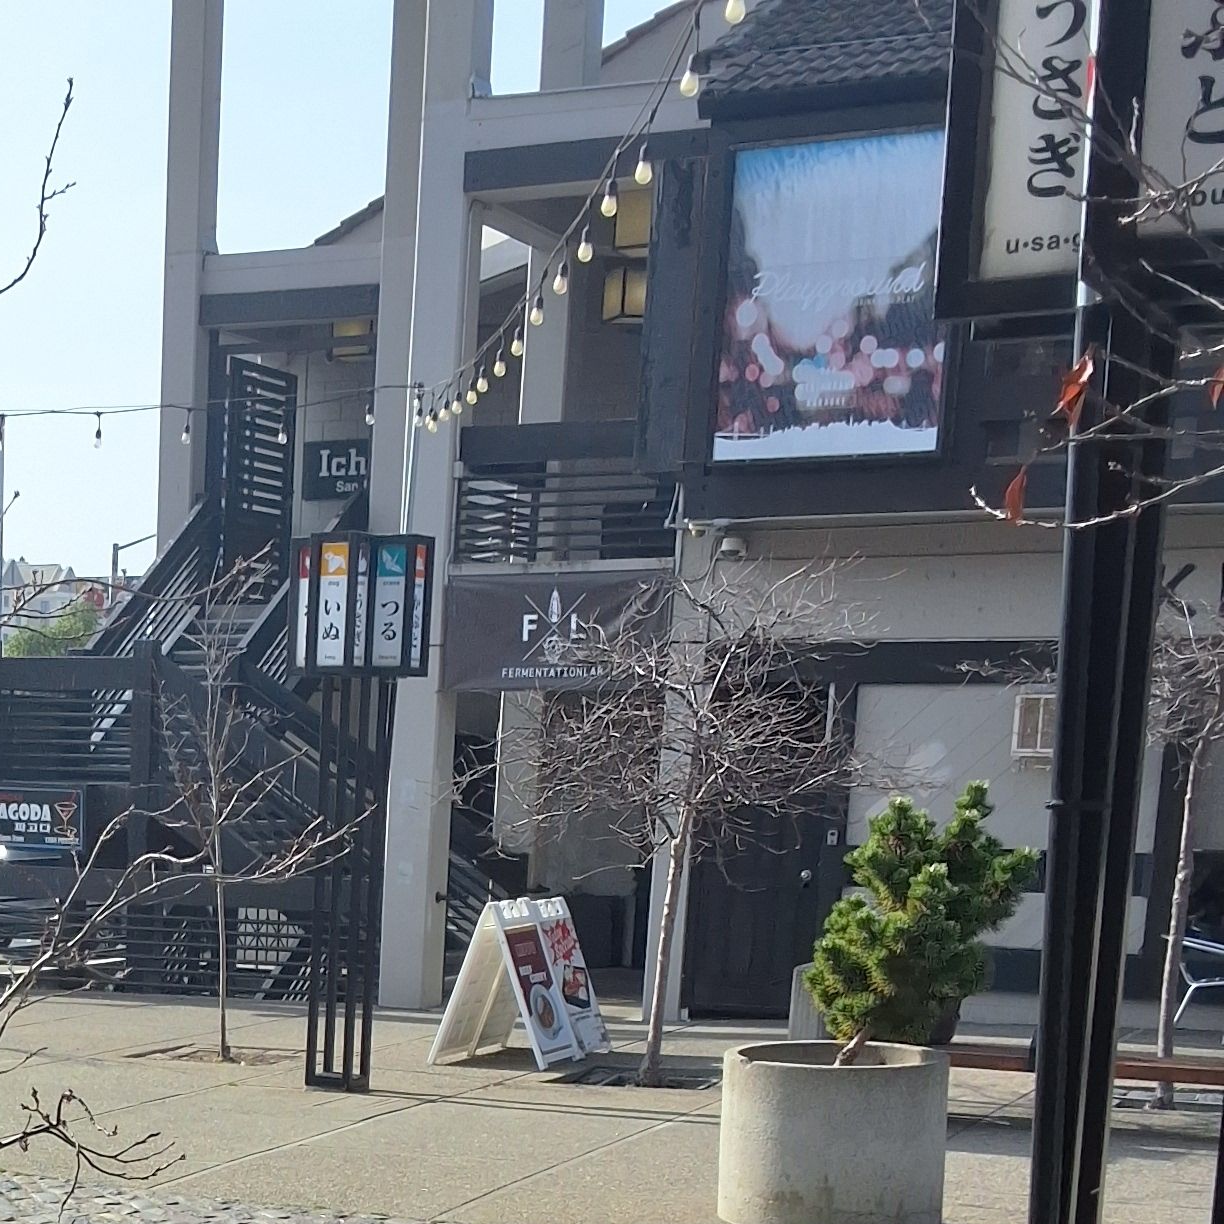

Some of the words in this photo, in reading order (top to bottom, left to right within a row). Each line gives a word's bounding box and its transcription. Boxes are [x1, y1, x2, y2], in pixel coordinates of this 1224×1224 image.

[319, 448, 366, 477] Ich
[322, 598, 341, 641] いぬ
[380, 600, 400, 641] つる
[522, 614, 538, 641] F
